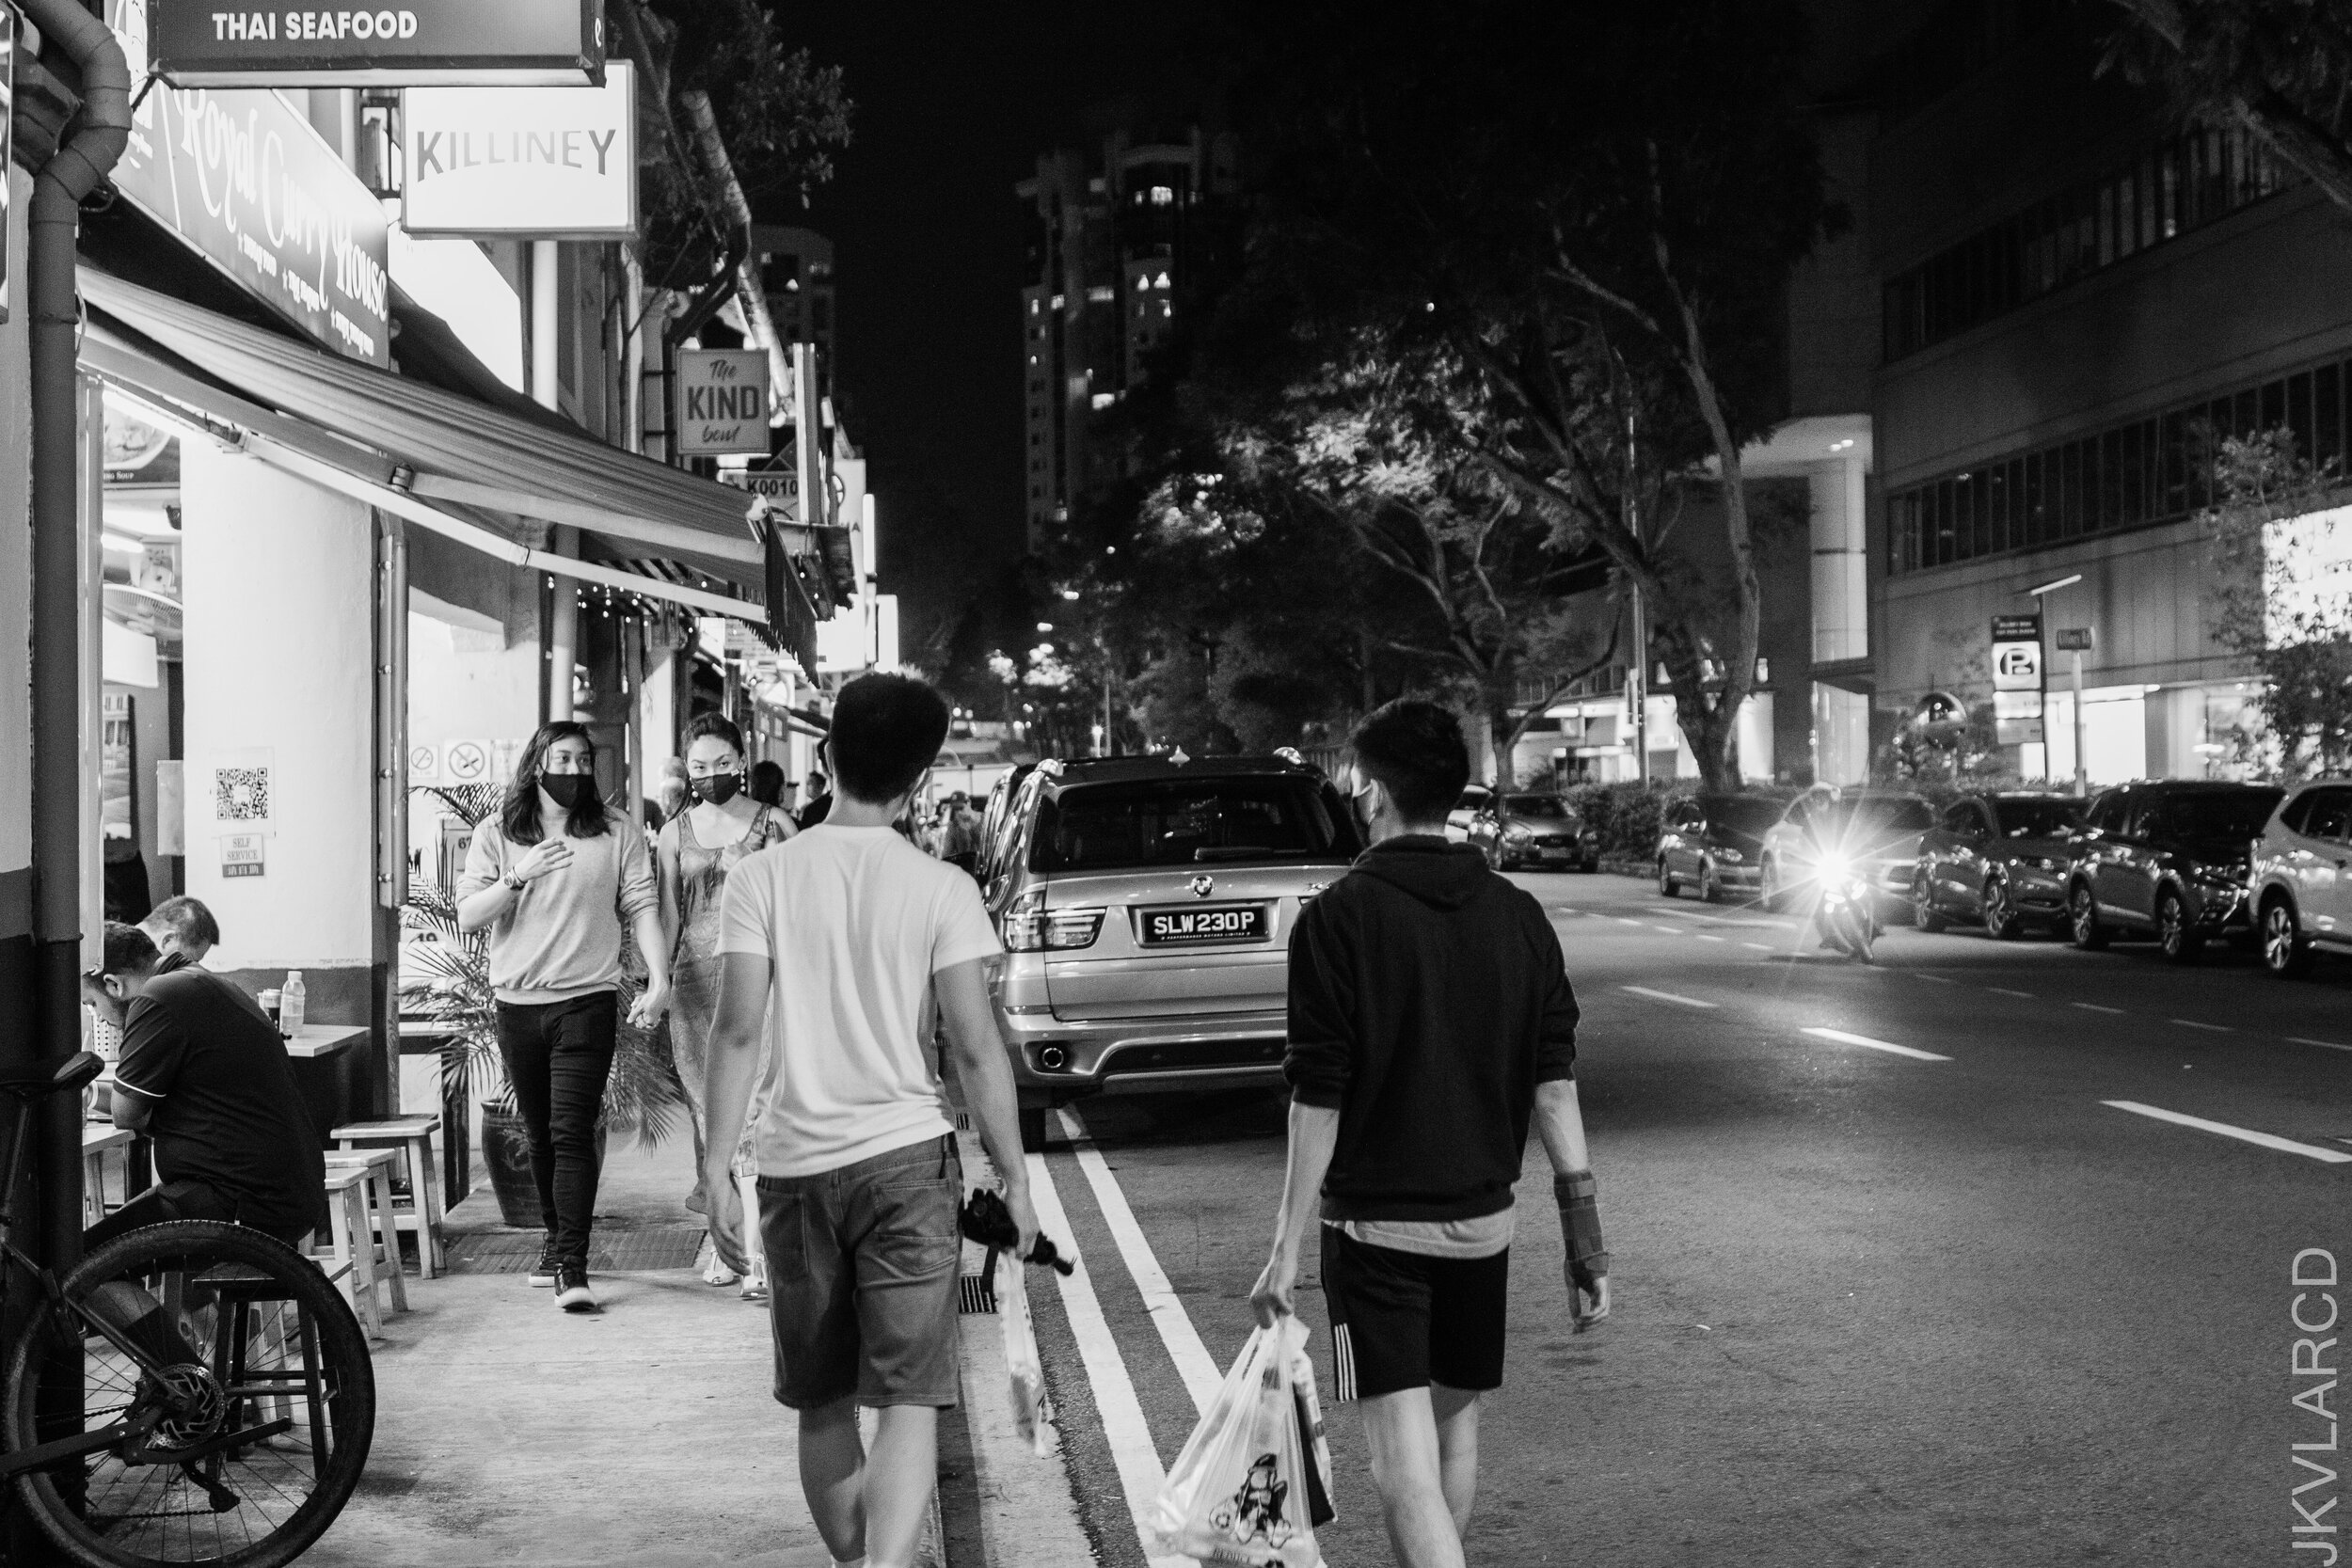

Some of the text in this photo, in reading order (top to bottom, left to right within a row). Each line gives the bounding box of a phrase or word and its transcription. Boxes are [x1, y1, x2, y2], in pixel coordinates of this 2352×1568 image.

[212, 10, 418, 40] THAI SEAFOOD
[417, 129, 616, 182] KILLINEY
[173, 88, 387, 322] Royal Curry House
[709, 359, 737, 381] The
[688, 386, 759, 420] KIND
[702, 425, 740, 444] bowl
[748, 478, 798, 496] K0010
[232, 837, 250, 847] SELF
[227, 849, 258, 861] SERVICE
[1153, 911, 1255, 935] SLW230P
